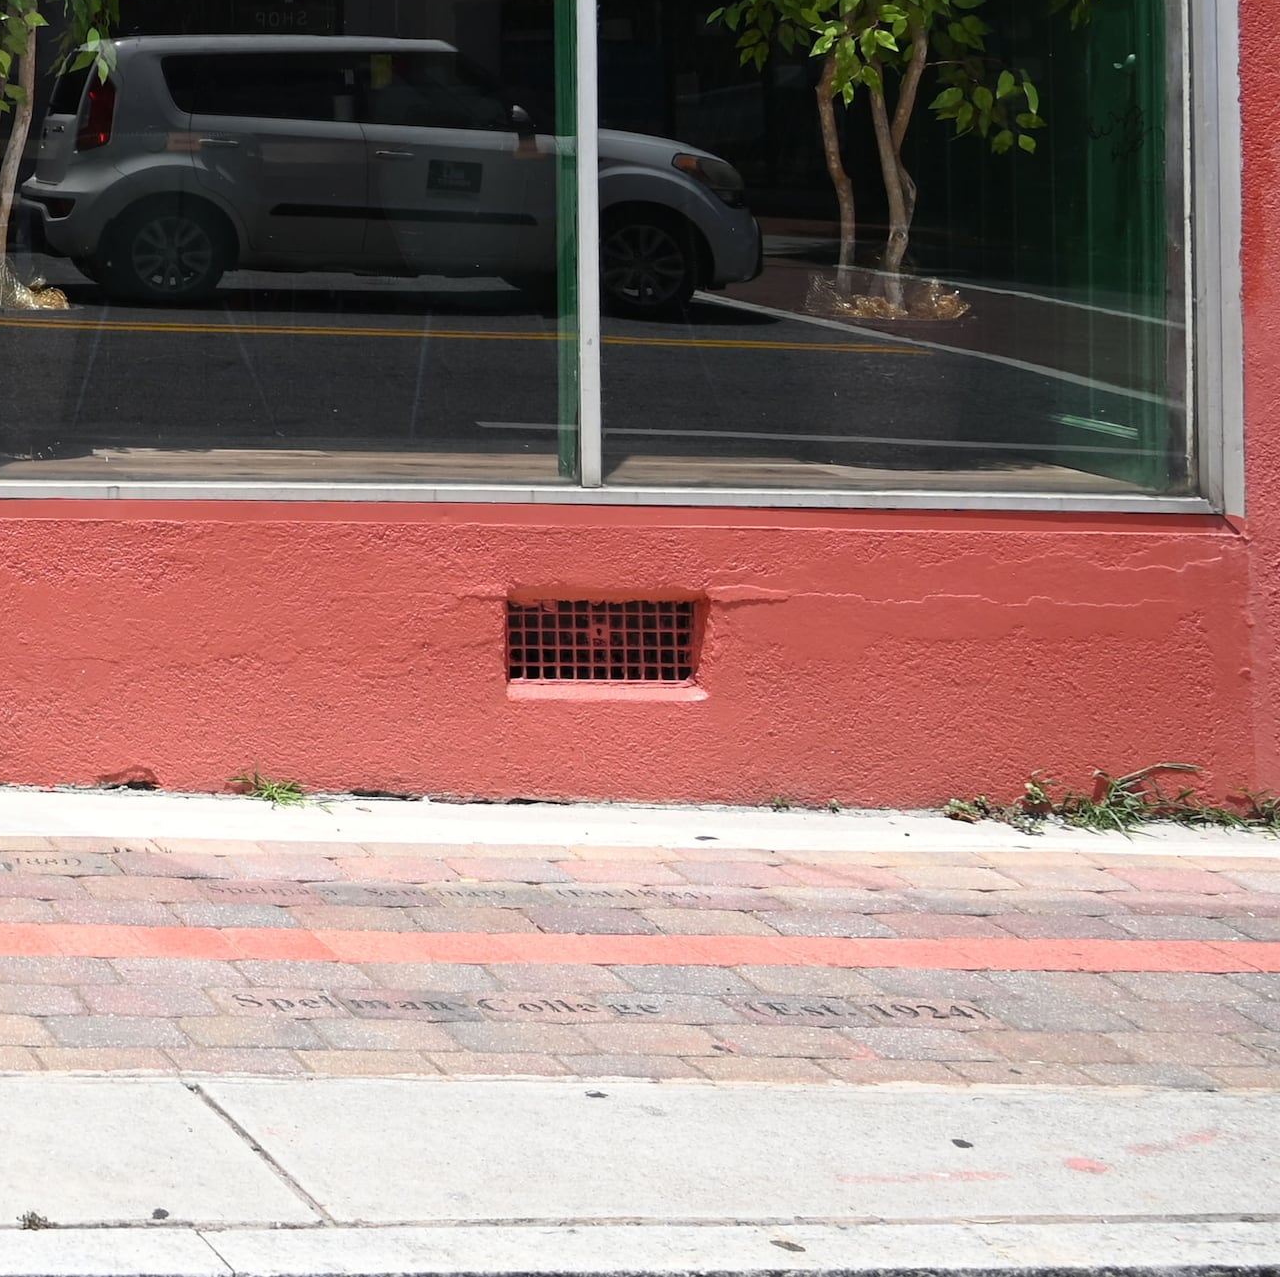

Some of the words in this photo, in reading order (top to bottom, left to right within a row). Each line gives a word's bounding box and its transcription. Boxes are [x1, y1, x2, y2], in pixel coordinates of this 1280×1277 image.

[231, 993, 454, 1013] Spelman
[476, 996, 662, 1017] College
[865, 1002, 992, 1020] 1924)
